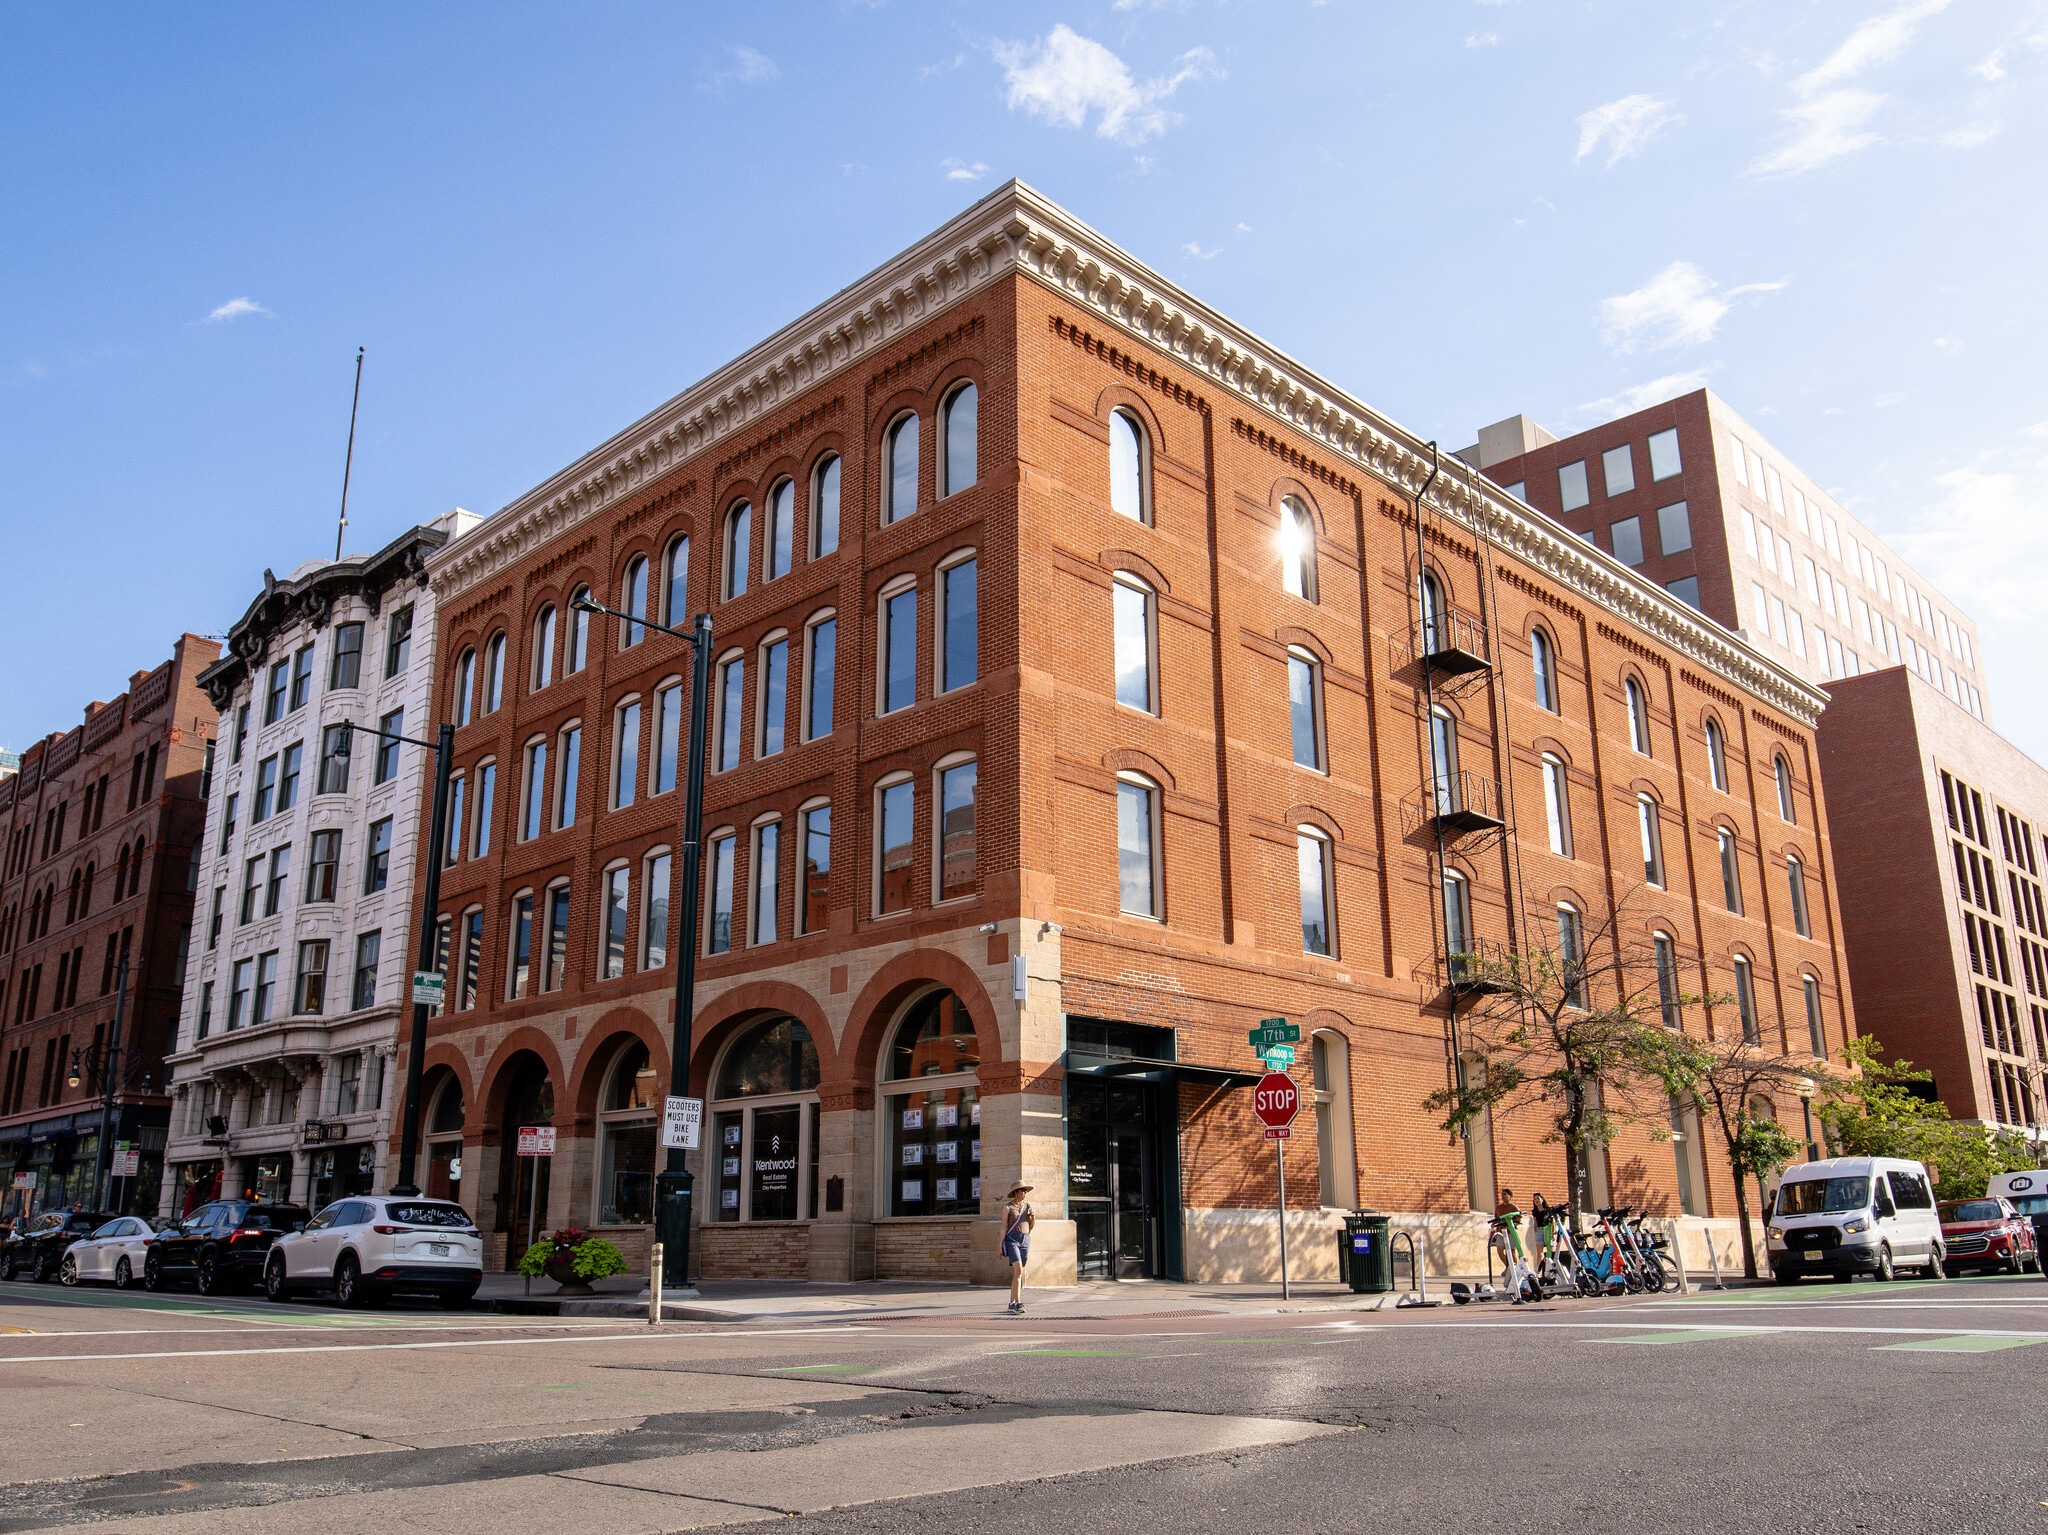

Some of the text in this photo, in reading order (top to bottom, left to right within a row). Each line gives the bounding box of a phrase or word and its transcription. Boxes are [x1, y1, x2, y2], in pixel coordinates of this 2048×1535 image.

[1263, 1029, 1285, 1041] 17th
[1259, 1044, 1288, 1060] Wynkoop
[1272, 1061, 1283, 1069] 1700
[1258, 1089, 1295, 1110] STOP
[667, 1101, 699, 1112] SCOOTERS
[667, 1112, 699, 1123] MUST USE
[674, 1123, 689, 1133] BIKE
[1267, 1129, 1289, 1138] ALL WAY
[672, 1135, 689, 1144] LANE
[755, 1156, 796, 1171] Kentwood
